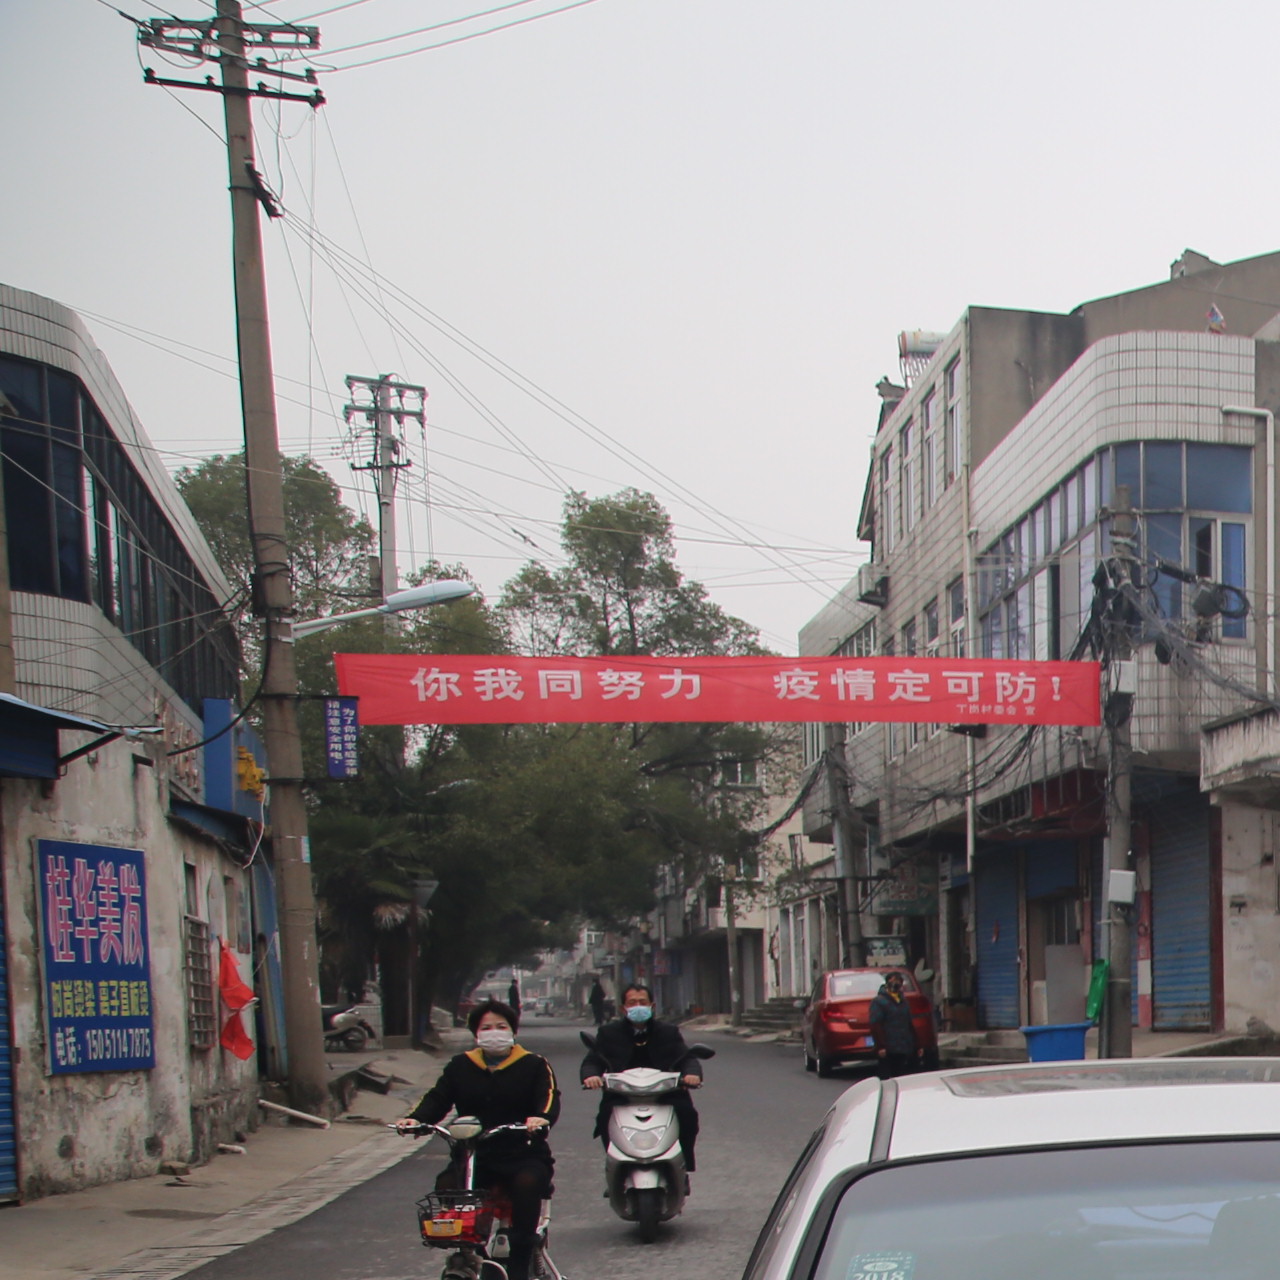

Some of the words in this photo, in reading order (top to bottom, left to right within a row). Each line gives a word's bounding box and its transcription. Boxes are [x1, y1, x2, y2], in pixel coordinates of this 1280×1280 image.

[409, 666, 702, 703] 你我同努力
[773, 666, 1062, 704] 疫情定可防！
[46, 855, 144, 969] 桂华美发
